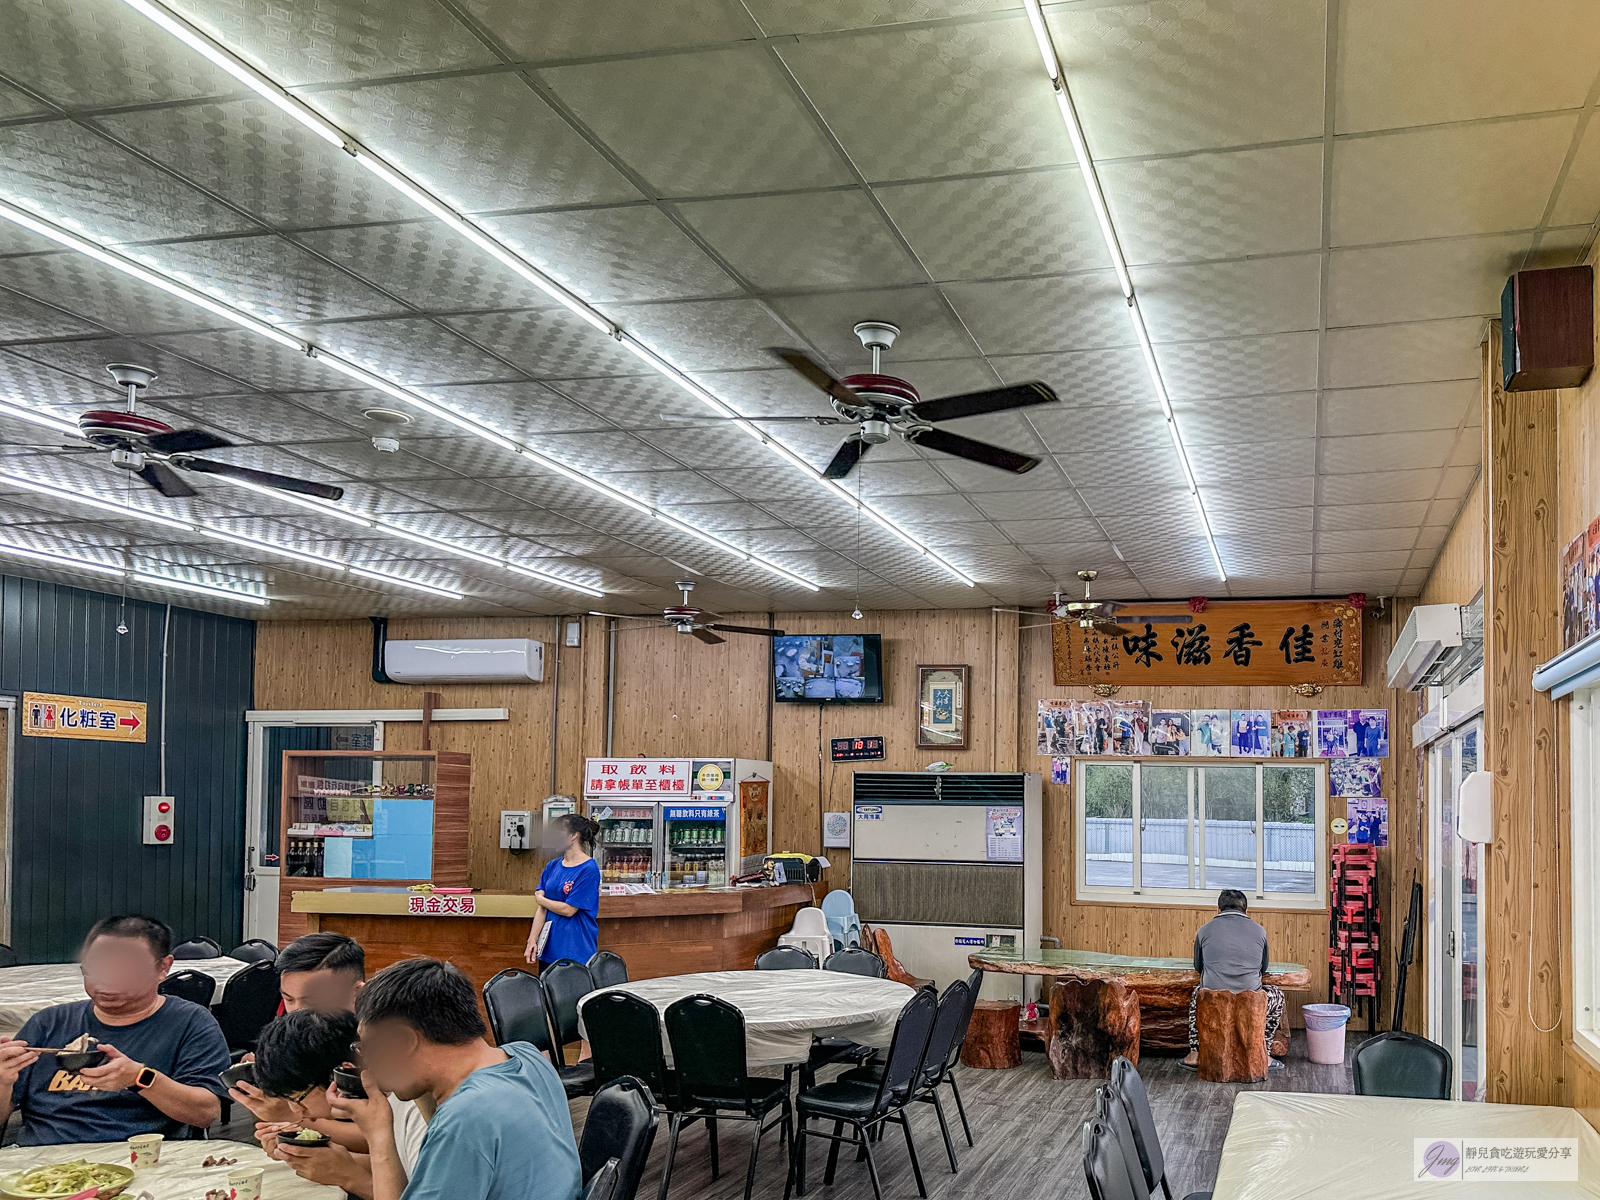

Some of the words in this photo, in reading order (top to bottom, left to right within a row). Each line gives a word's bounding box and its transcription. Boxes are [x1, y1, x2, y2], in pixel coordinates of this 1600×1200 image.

[60, 707, 116, 730] 化粧室
[590, 779, 684, 790] 請拿帳單至櫃檯
[410, 897, 474, 913] 現金交易
